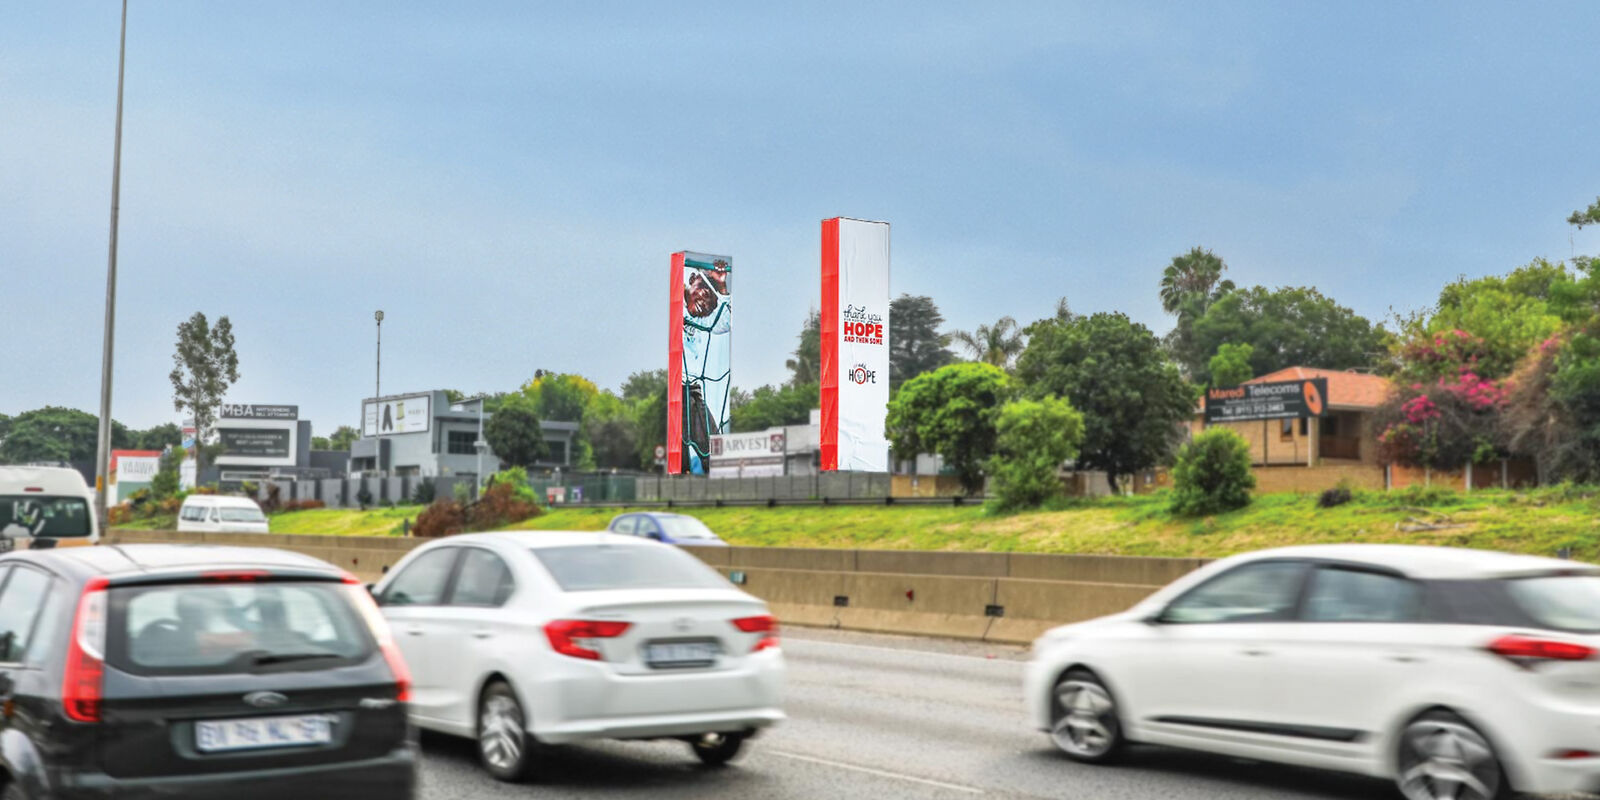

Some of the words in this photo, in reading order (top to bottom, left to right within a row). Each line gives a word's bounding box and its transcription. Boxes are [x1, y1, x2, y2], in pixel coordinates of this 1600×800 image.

[844, 321, 883, 338] HOPE
[848, 368, 877, 385] HOPE
[1209, 388, 1245, 399] Maredi
[1248, 384, 1300, 397] Telecoms
[221, 405, 254, 417] MBA
[711, 437, 768, 456] HARVEST
